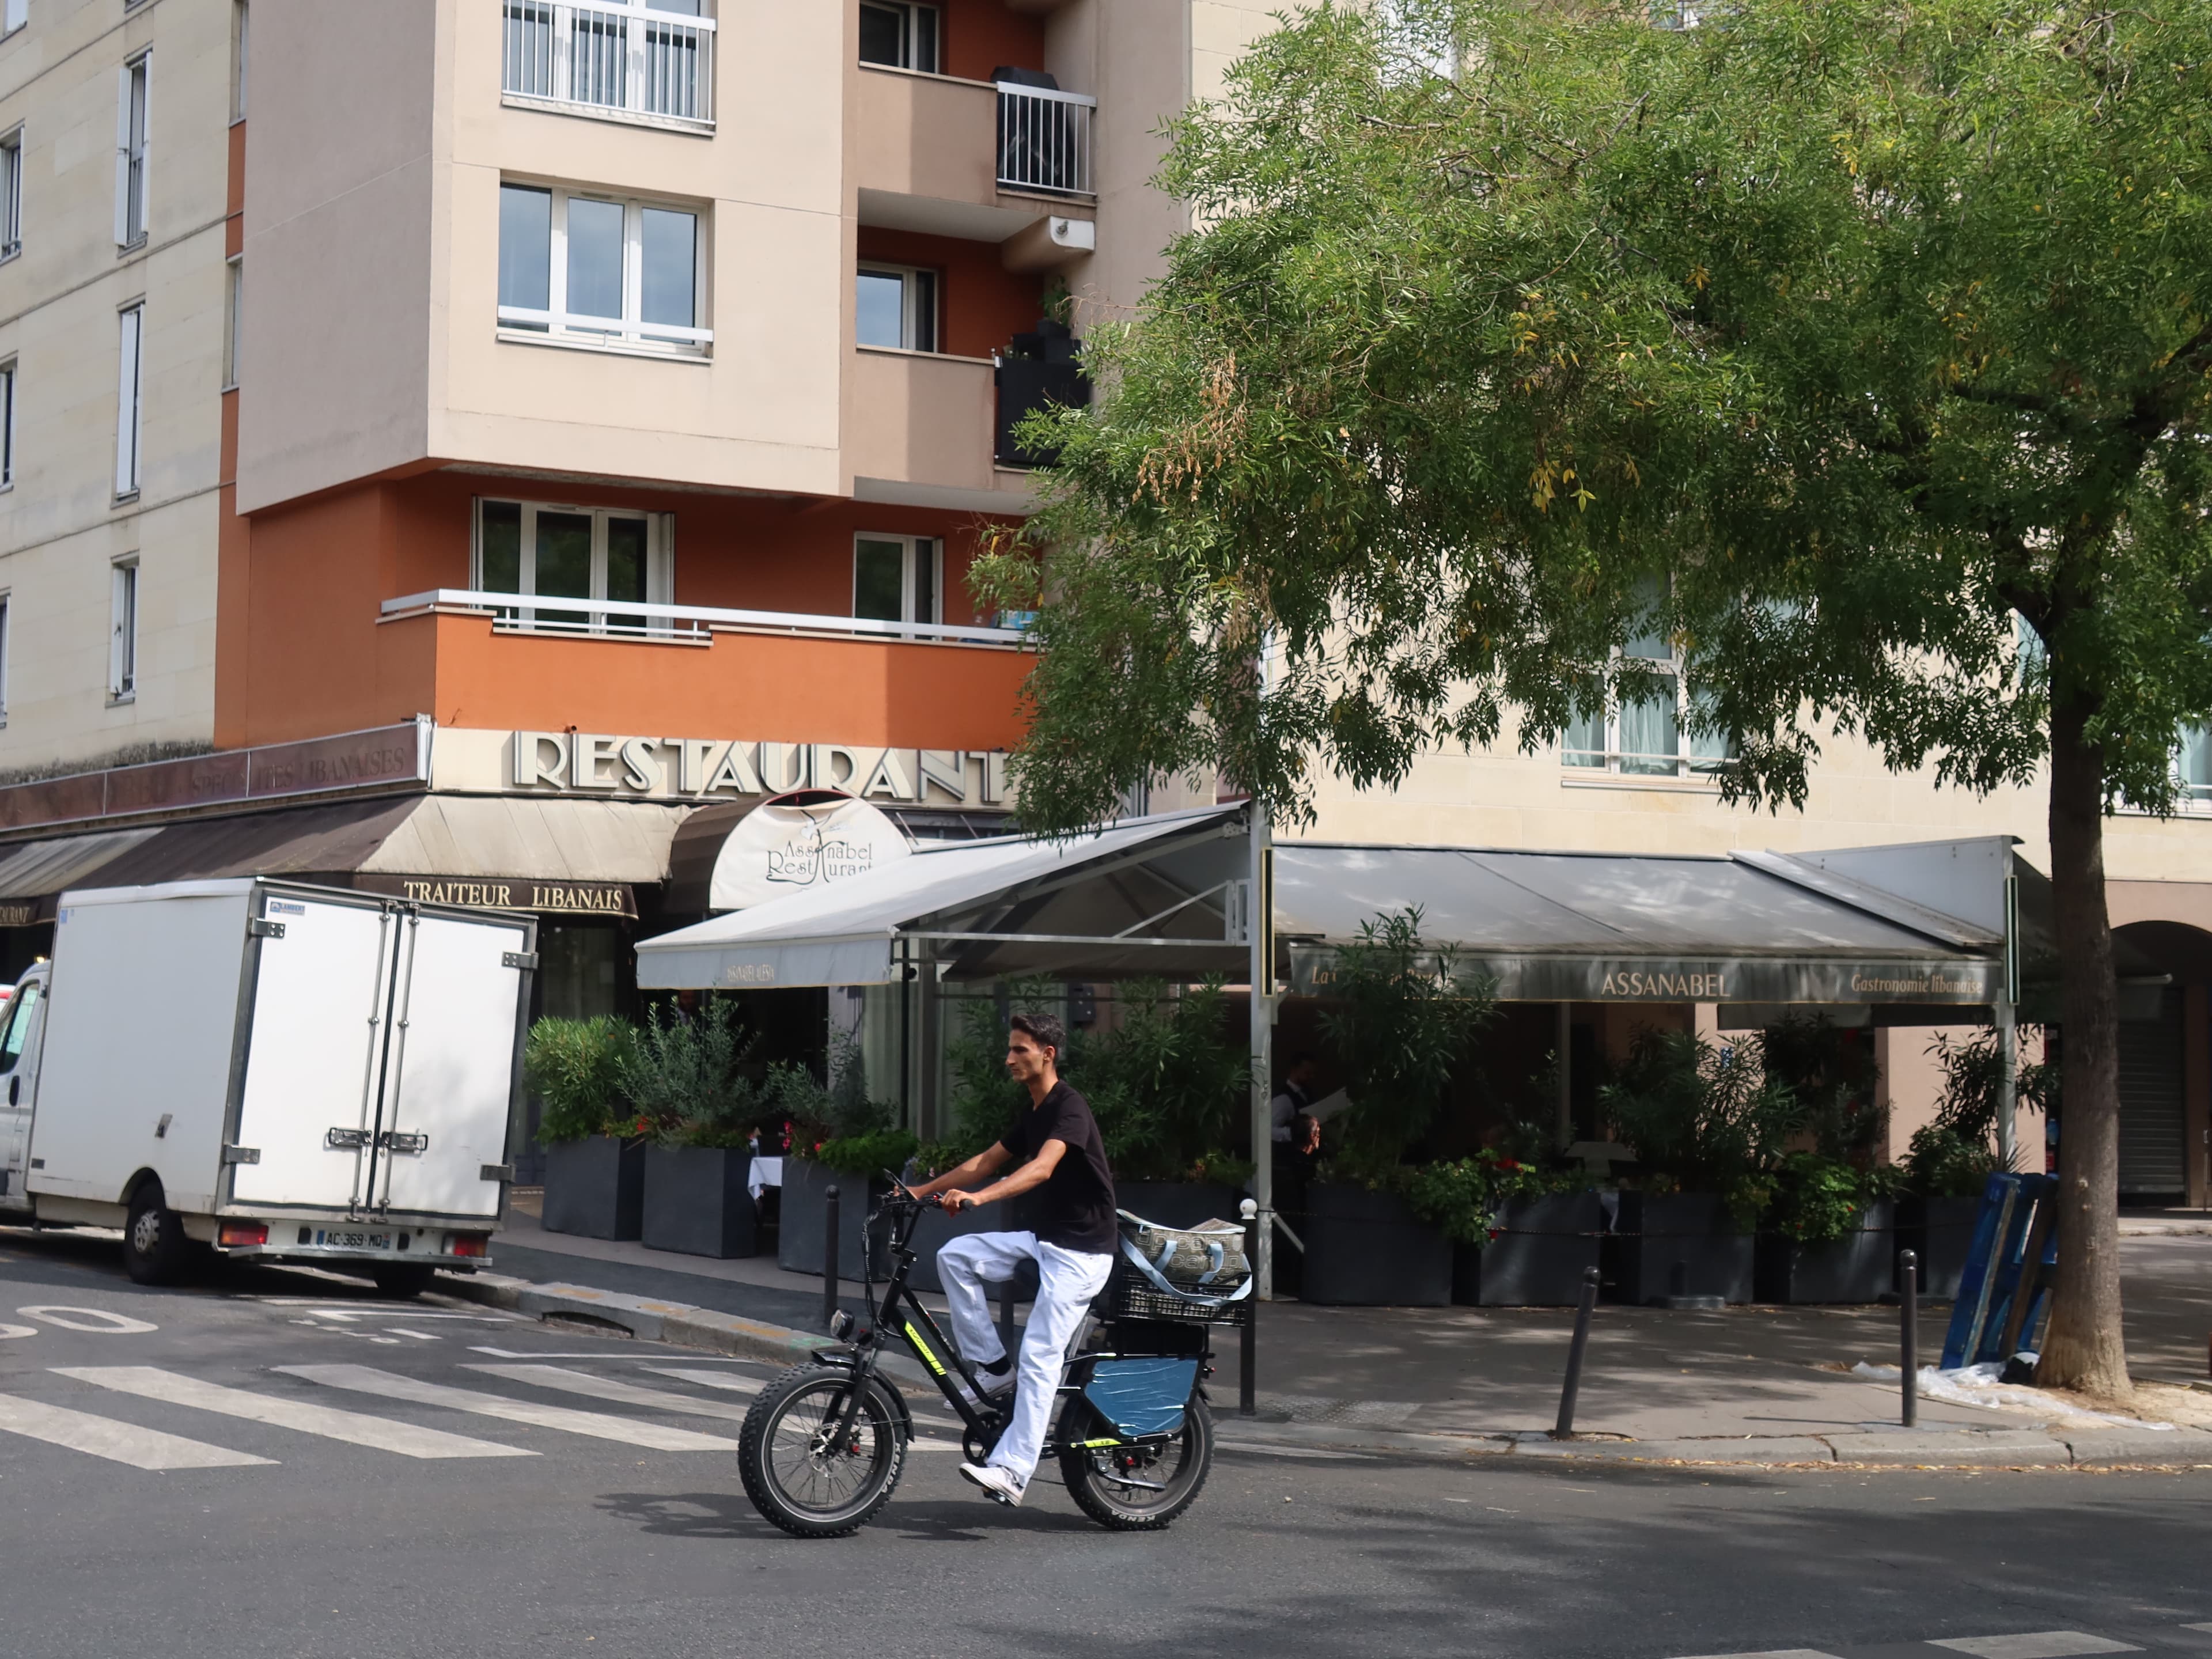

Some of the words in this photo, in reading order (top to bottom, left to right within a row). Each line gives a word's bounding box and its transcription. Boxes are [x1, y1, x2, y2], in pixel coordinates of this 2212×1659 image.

[513, 730, 1011, 803] RESTAURANT
[404, 881, 511, 906] TRAITEUR
[532, 888, 622, 910] LIBANAIS
[1601, 972, 1731, 997] ASSANABEL
[1851, 974, 1929, 993] Gastronomie
[1931, 975, 1983, 994] libanaise
[1111, 1509, 1157, 1522] KENDA
